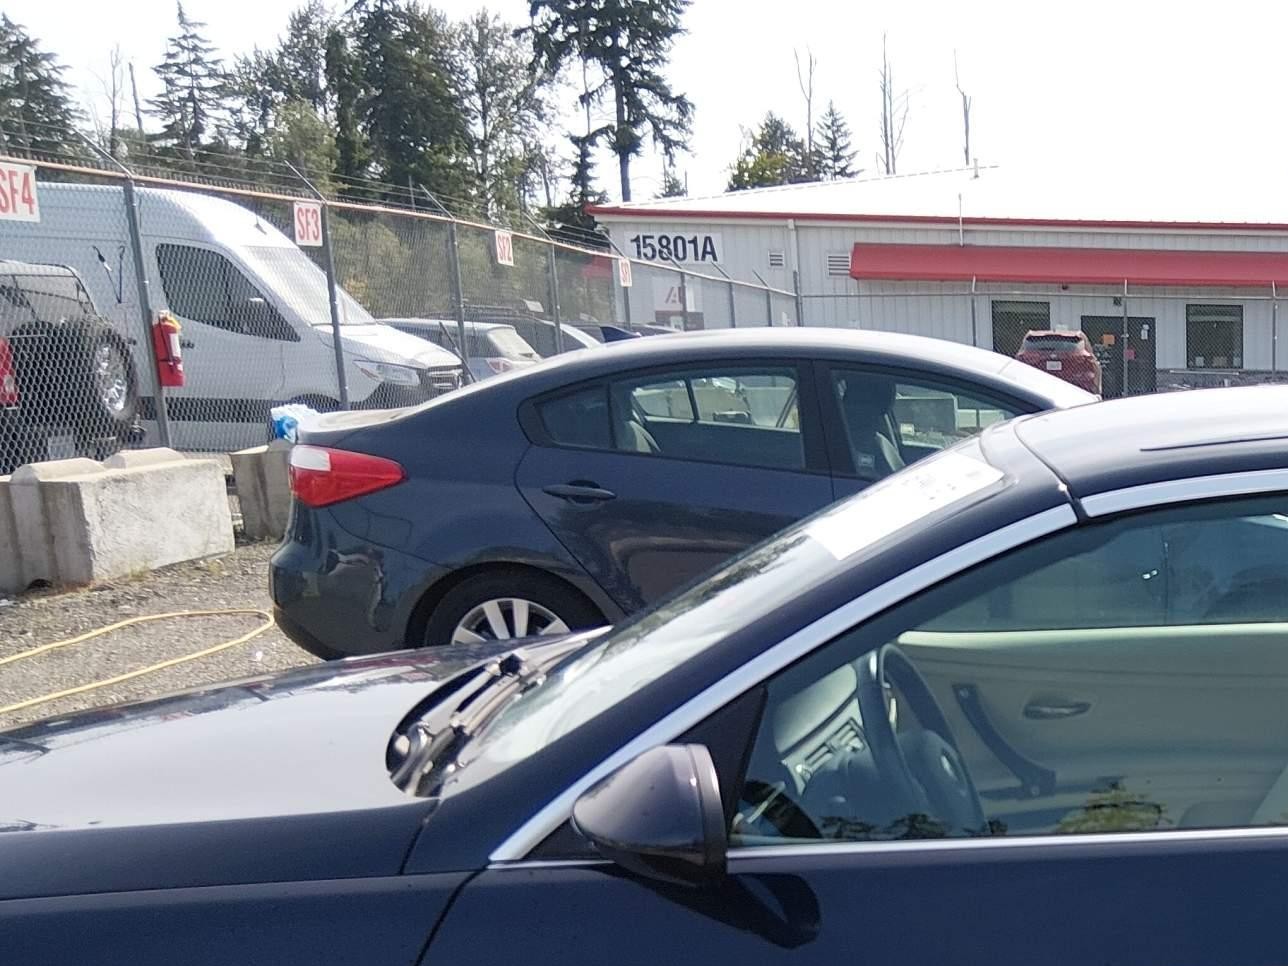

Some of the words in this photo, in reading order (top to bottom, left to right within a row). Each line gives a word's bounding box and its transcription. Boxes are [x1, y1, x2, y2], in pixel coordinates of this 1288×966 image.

[0, 168, 35, 215] SF4
[297, 206, 320, 241] SF3
[630, 234, 718, 262] 15801A
